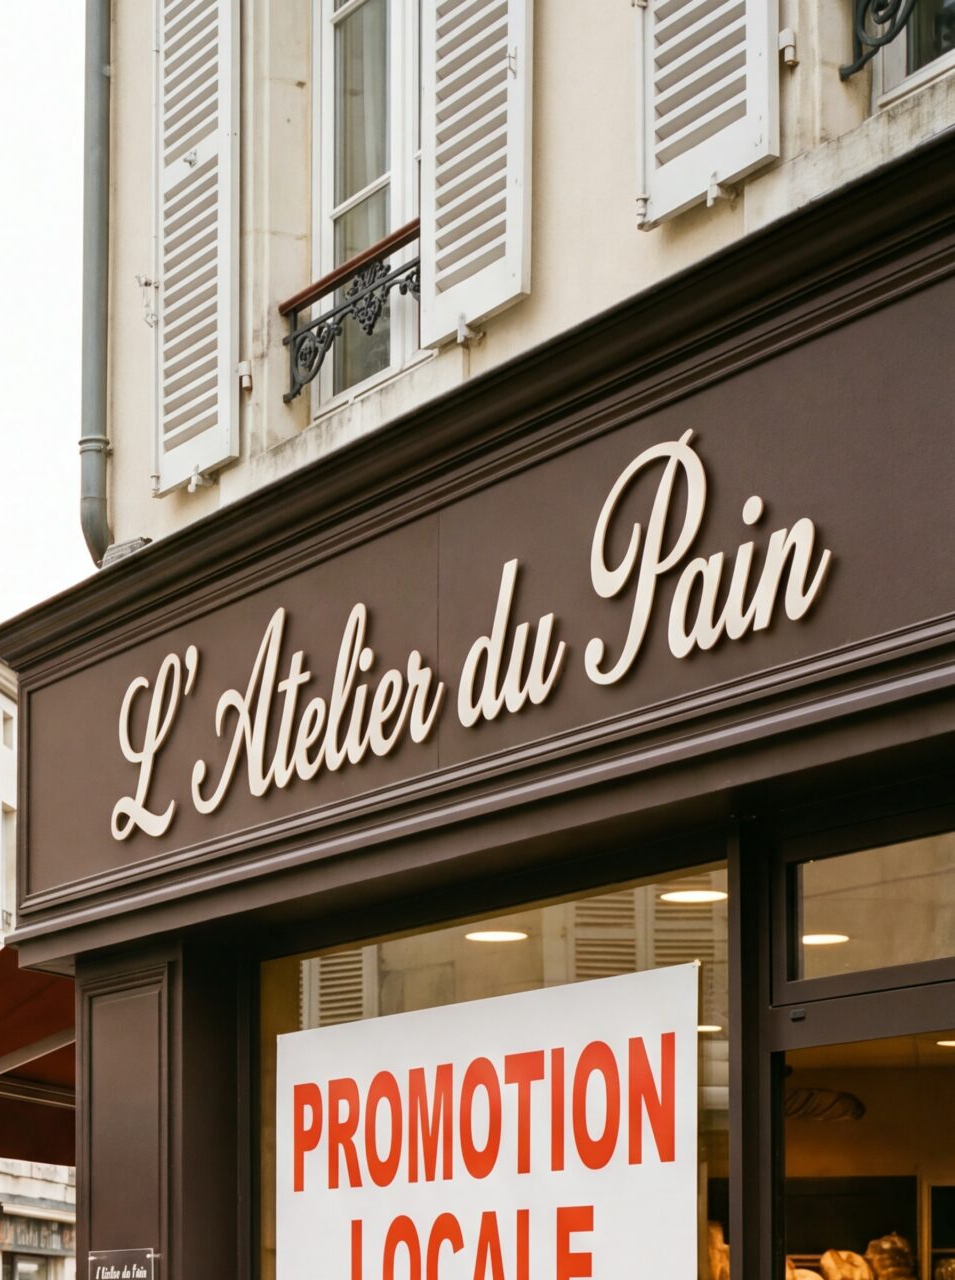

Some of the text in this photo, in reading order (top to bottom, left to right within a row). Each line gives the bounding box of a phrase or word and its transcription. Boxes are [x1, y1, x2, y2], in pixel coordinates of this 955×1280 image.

[458, 559, 565, 728] du
[585, 428, 831, 685] Pain
[293, 1031, 676, 1192] PROMOTION
